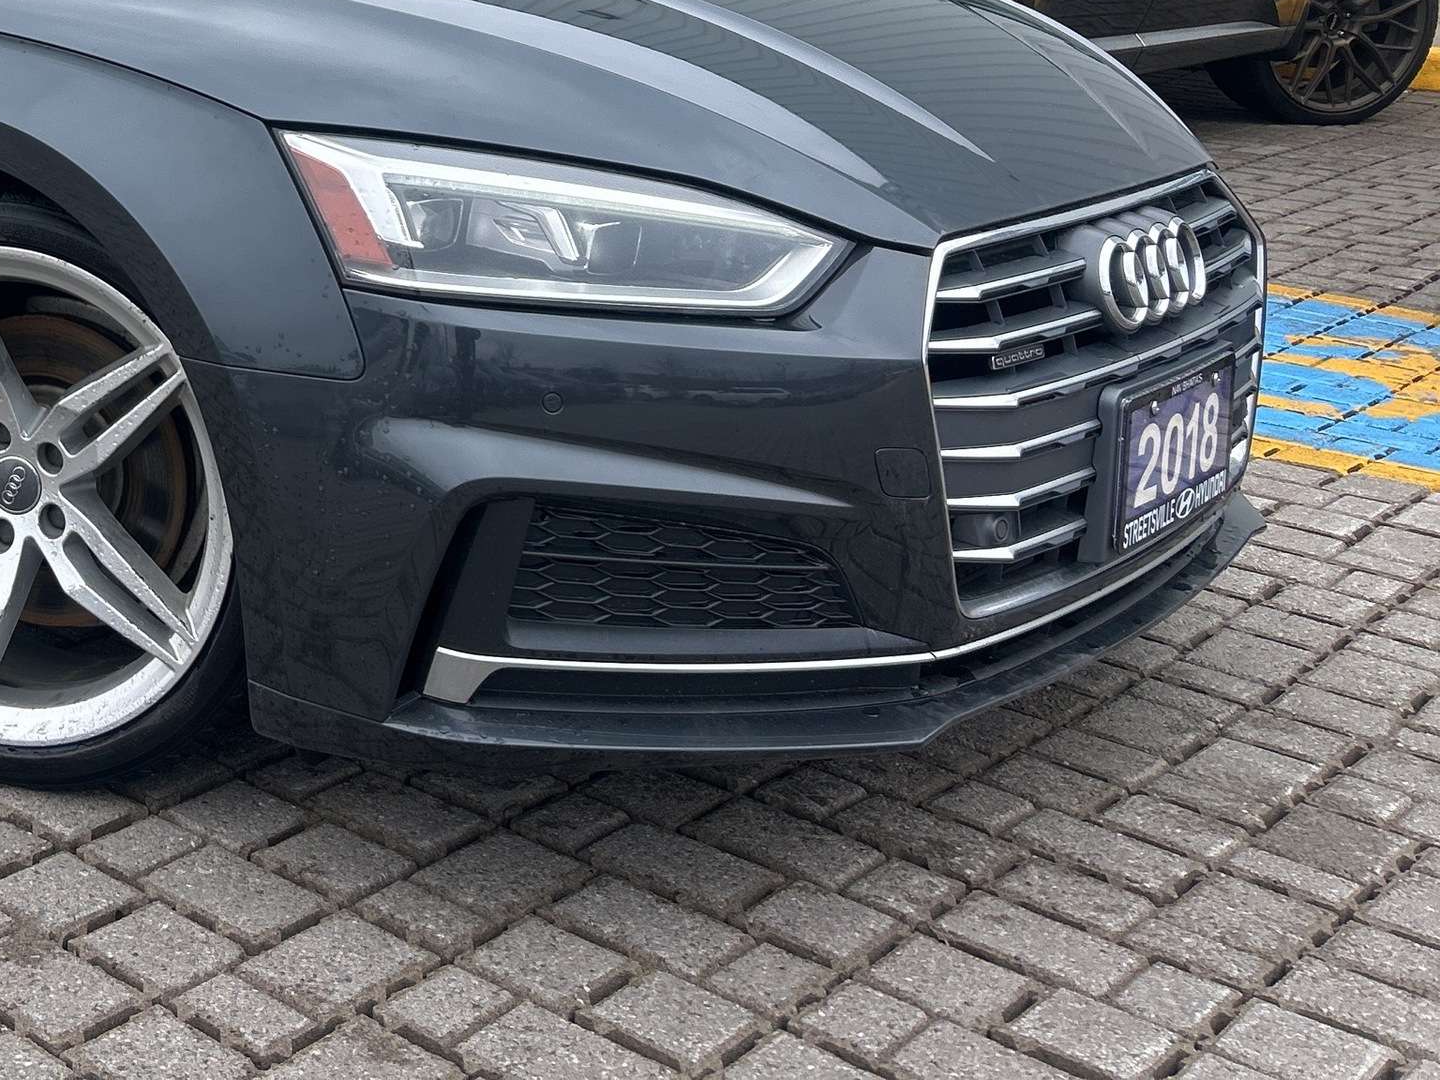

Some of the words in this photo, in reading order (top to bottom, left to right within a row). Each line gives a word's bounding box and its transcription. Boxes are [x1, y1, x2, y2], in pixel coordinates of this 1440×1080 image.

[995, 347, 1043, 367] quattro
[1133, 392, 1220, 509] 2018
[1122, 498, 1177, 550] STREETSVILLE
[1194, 469, 1227, 509] HYUNDAI
